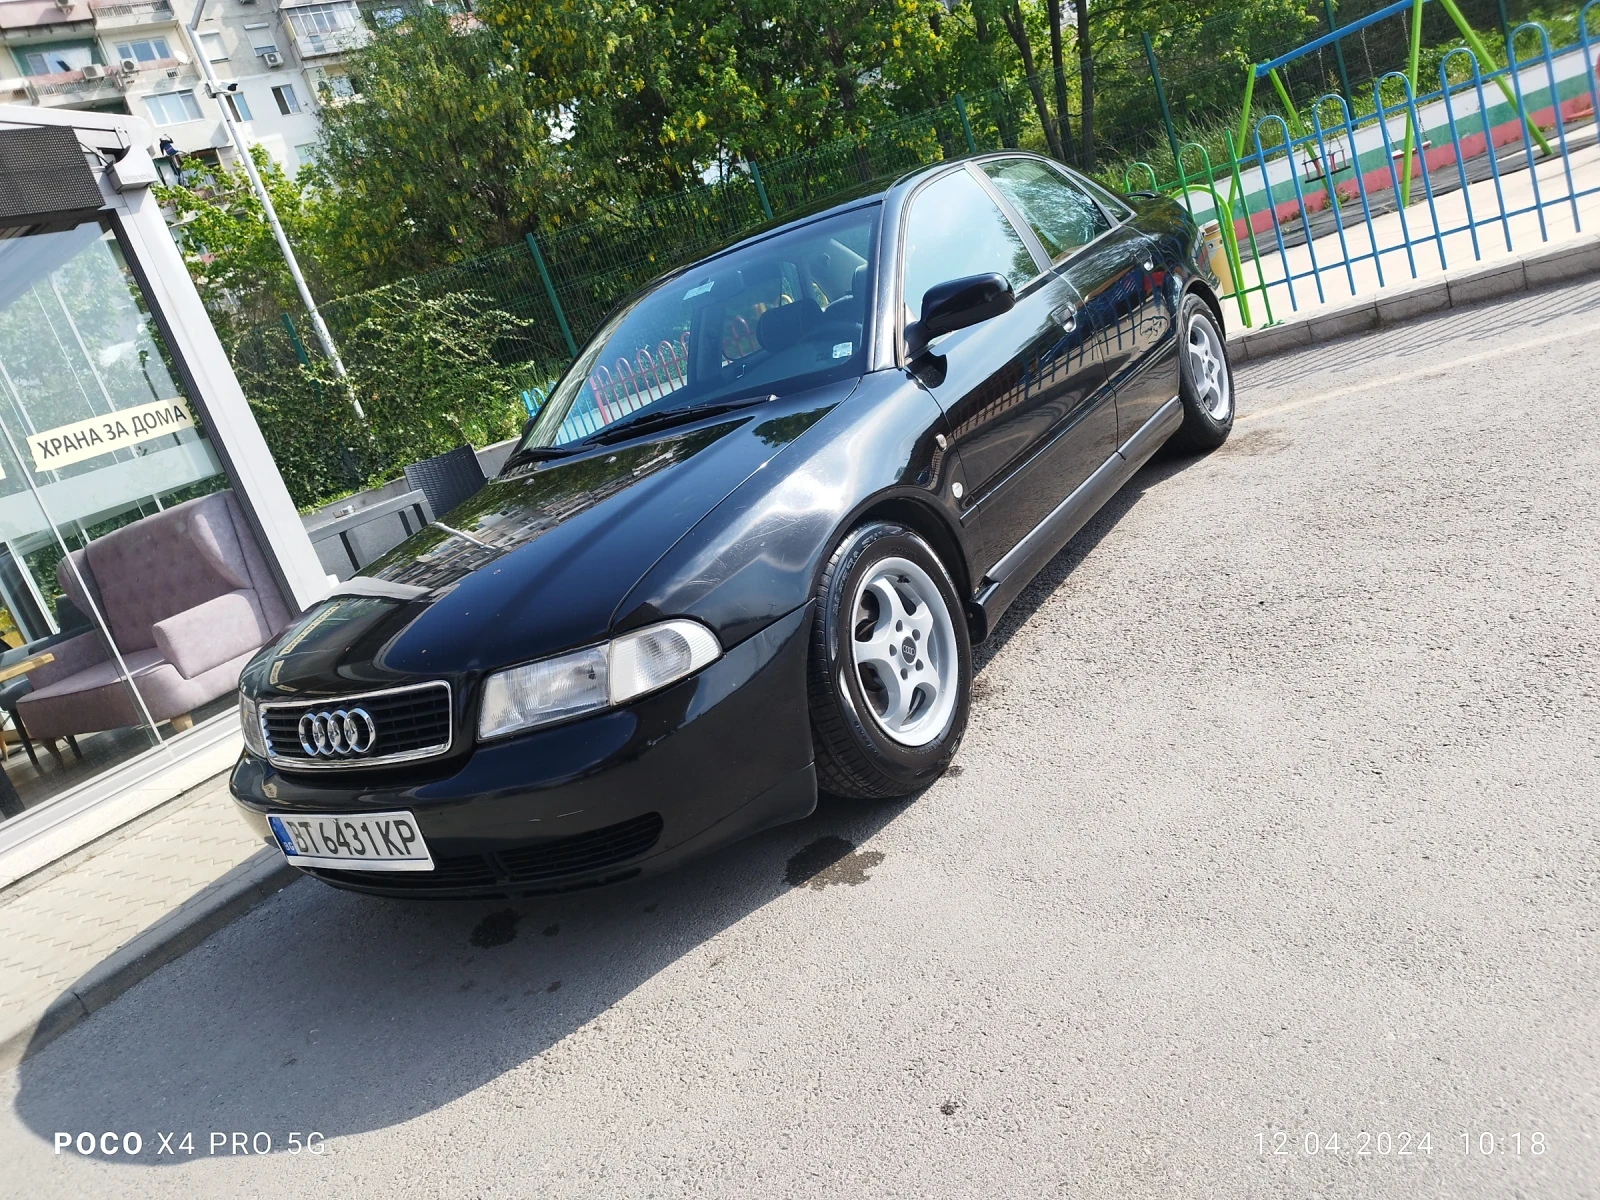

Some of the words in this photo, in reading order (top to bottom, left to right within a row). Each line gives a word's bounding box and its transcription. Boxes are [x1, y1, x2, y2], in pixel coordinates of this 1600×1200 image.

[37, 428, 103, 459] ХРАНА
[103, 421, 130, 440] ЗА
[131, 405, 187, 437] ДОМА
[282, 841, 295, 851] BG
